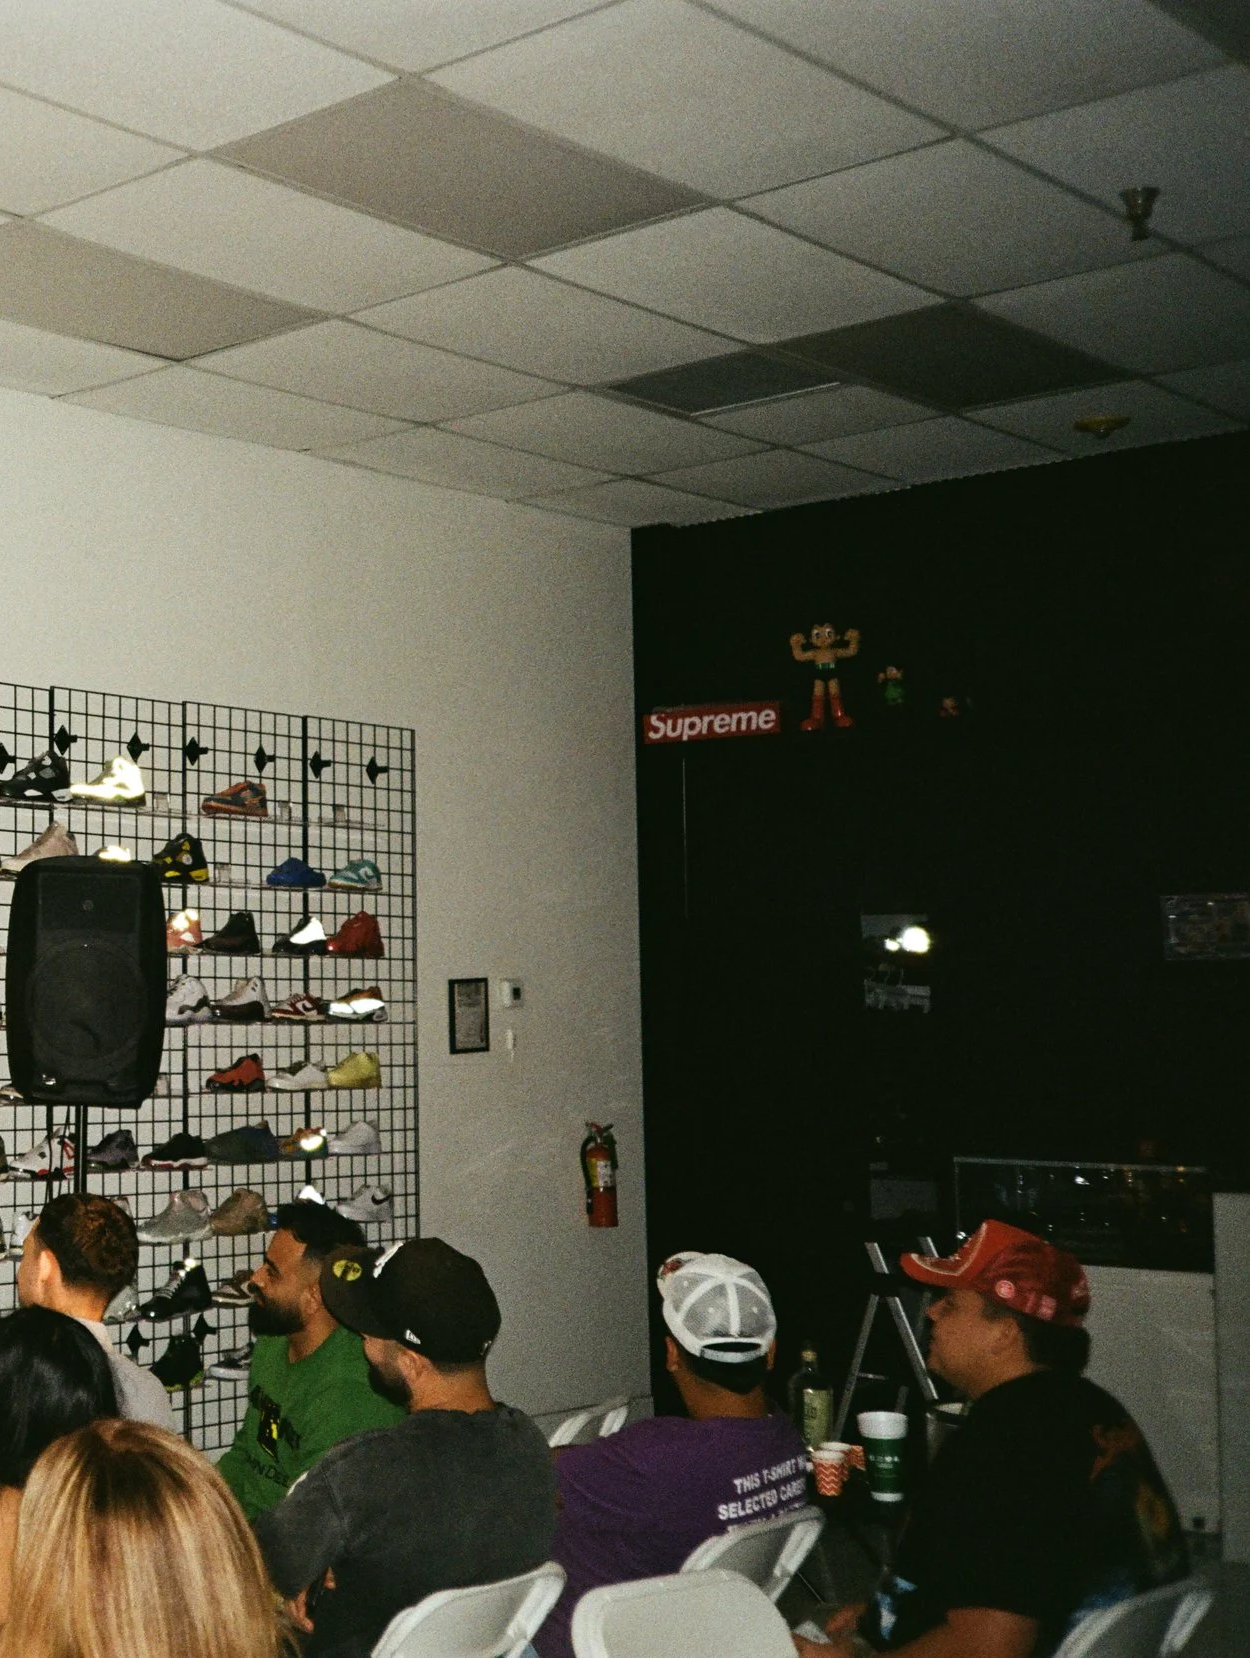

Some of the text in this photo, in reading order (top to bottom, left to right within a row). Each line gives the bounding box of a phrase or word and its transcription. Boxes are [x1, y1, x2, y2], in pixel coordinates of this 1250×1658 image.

[648, 709, 776, 741] Supreme
[733, 1472, 761, 1495] THIS
[762, 1458, 797, 1484] T-SHIRT
[717, 1488, 779, 1521] SELECTED
